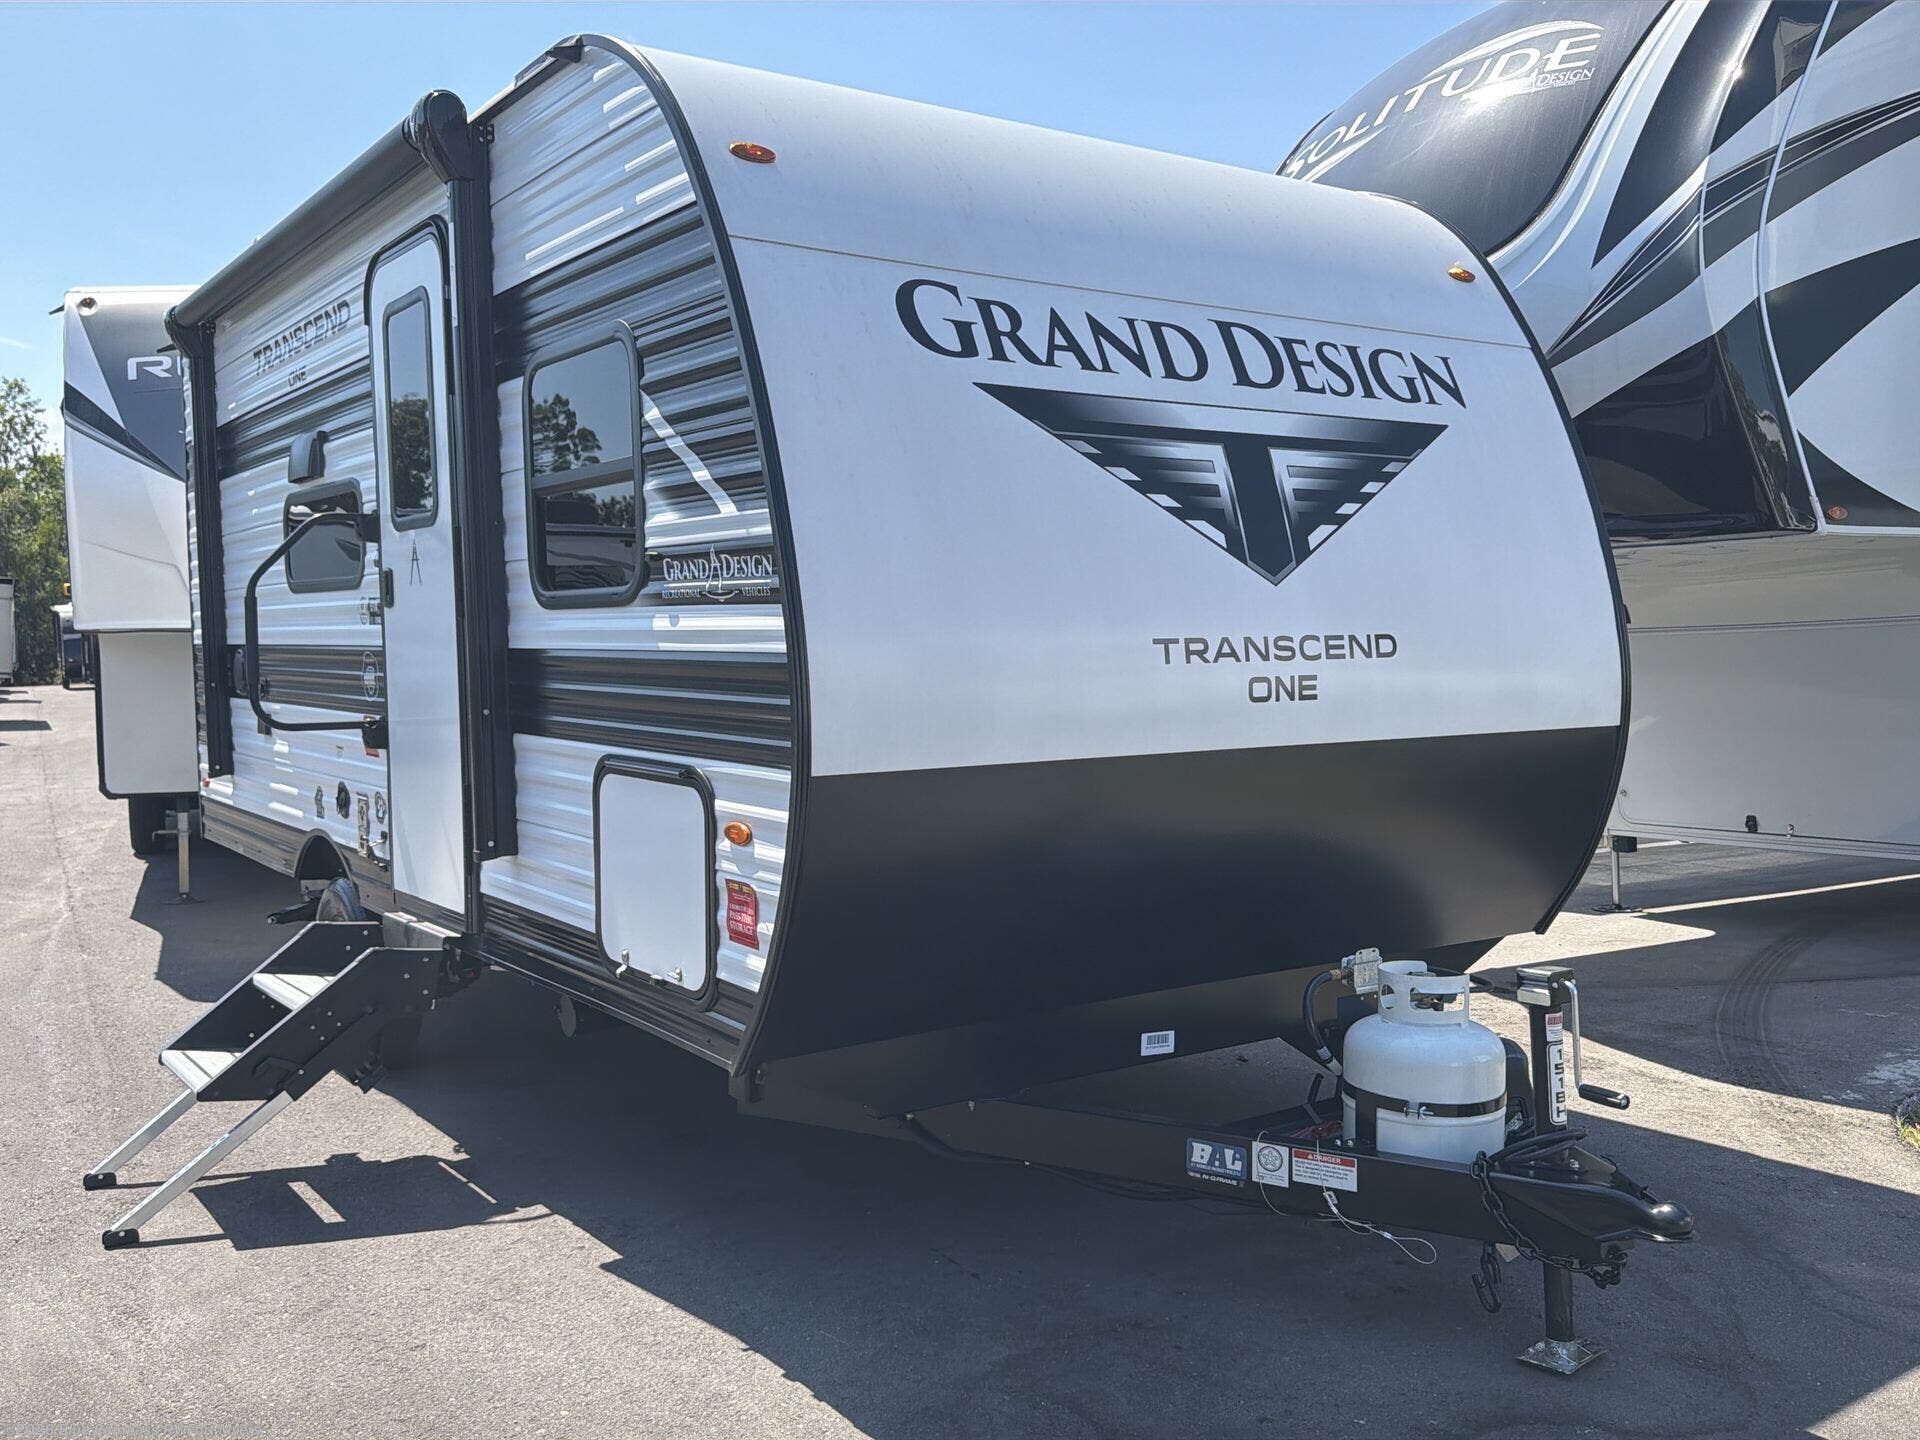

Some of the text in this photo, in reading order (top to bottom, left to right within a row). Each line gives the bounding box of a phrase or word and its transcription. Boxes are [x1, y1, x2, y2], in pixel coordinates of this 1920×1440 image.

[1535, 67, 1596, 87] DESIGN
[253, 300, 351, 376] TRANSCEND
[895, 279, 1466, 410] GRAND DESIGN
[127, 355, 182, 380] R
[288, 365, 308, 388] ONE
[663, 554, 773, 581] GRAND DESIGN
[741, 586, 771, 597] VEHICLES
[1153, 633, 1398, 664] TRANSCEND
[1248, 674, 1319, 703] ONE
[1191, 1142, 1242, 1171] BAL
[1313, 1154, 1342, 1165] DANGER
